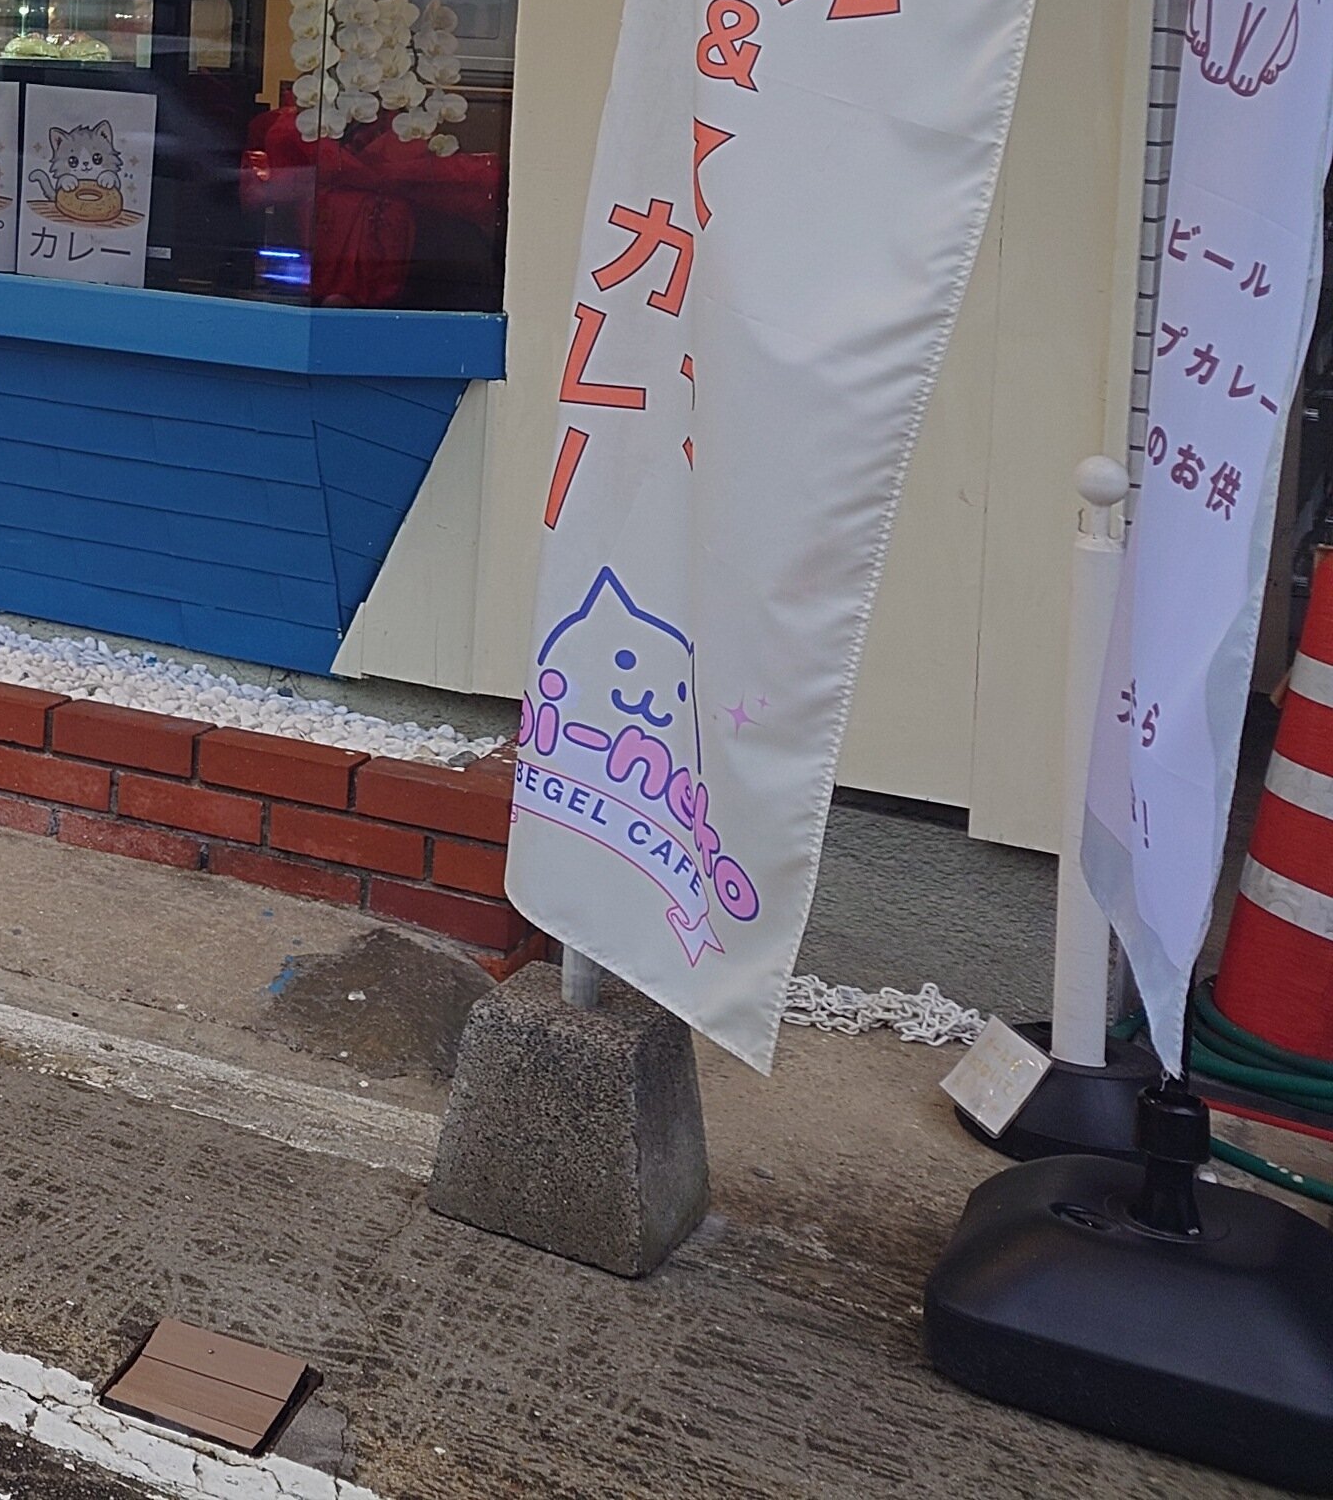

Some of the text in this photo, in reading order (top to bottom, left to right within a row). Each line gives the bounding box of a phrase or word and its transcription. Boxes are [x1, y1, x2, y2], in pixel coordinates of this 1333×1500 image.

[30, 226, 132, 262] カレー
[1167, 217, 1271, 298] ビール
[541, 197, 697, 531] カレー
[627, 820, 704, 898] CAFE
